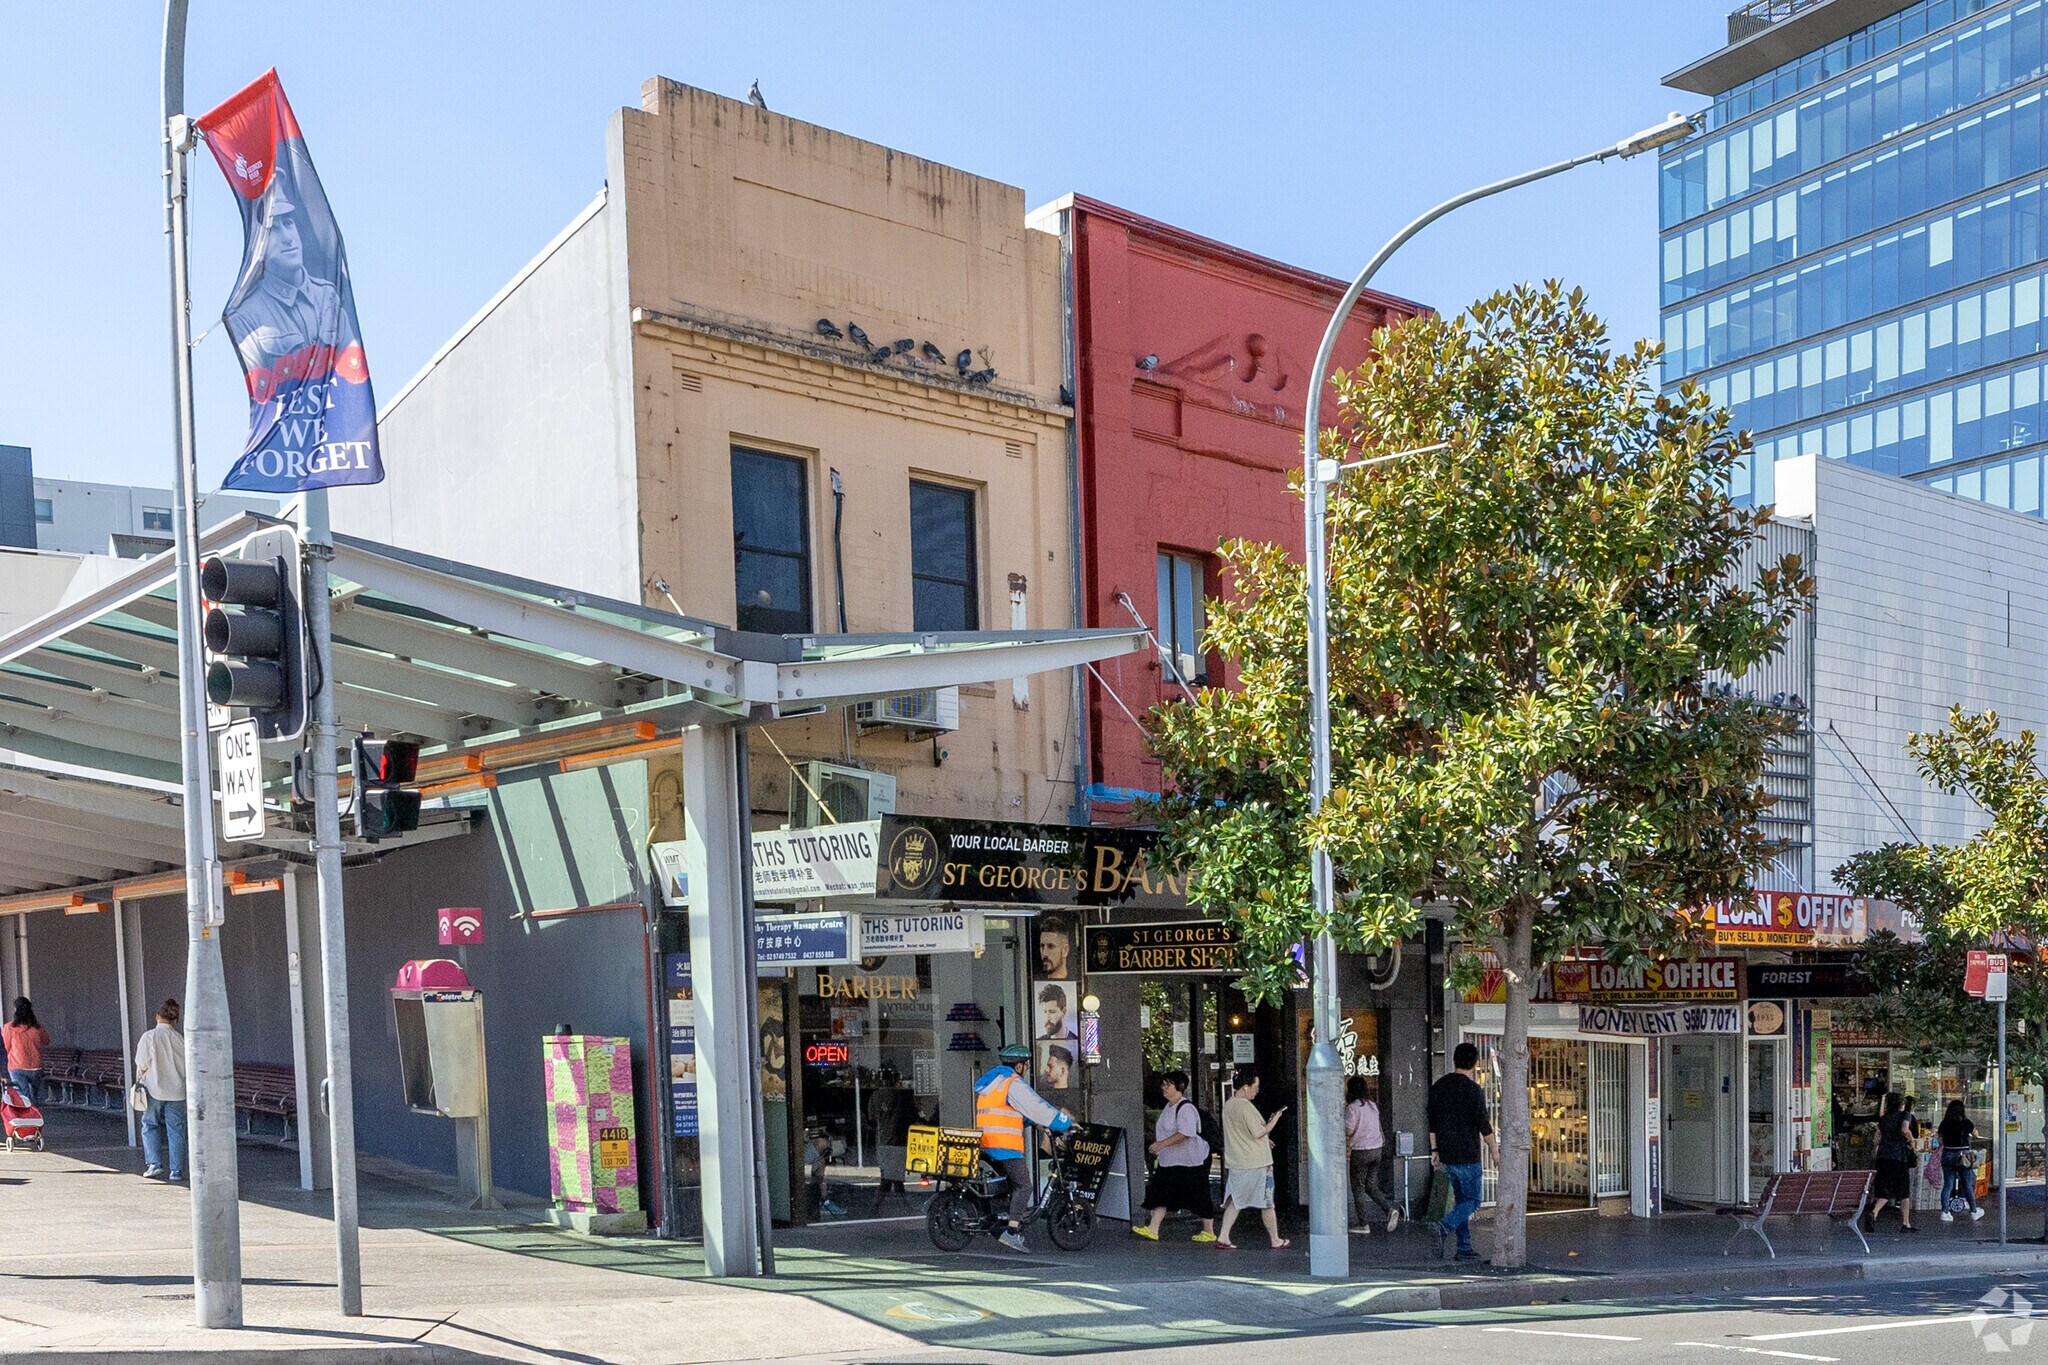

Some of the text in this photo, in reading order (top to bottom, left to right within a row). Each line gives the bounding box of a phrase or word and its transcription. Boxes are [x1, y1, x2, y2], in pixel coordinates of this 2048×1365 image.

[277, 418, 329, 448] WE
[225, 731, 253, 760] ONE
[225, 767, 255, 796] WAY
[788, 832, 873, 864] TUTORING
[949, 834, 1069, 854] YOUR LOCAL BARBER
[663, 854, 680, 864] WMT
[942, 862, 972, 886] ST
[979, 864, 1088, 891] GEORGE'S
[1777, 895, 1793, 929] $
[1796, 895, 1864, 930] OFFICE
[765, 922, 792, 933] Therapy
[793, 920, 819, 931] Massage
[820, 919, 844, 929] Centre
[894, 915, 964, 933] TUTORING
[757, 935, 802, 949] 疗按摩中心
[1133, 927, 1231, 944] ST GEORGE'S
[1718, 931, 1736, 942] BUY,
[1738, 932, 1755, 942] SELL
[1758, 932, 1764, 942] &
[1766, 933, 1793, 943] MONEY
[1794, 934, 1814, 944] LENT
[1118, 948, 1187, 969] BARBER
[1558, 965, 1585, 974] ANNA
[1590, 961, 1736, 992] LOAN $ OFFICE
[1761, 971, 1812, 984] FOREST
[817, 974, 918, 1000] BARBER
[1662, 991, 1680, 999] LENT
[1581, 1007, 1637, 1033] MONEY
[1639, 1011, 1678, 1034] LENT
[1710, 1008, 1737, 1031] 7071
[806, 1045, 849, 1062] OPEN
[601, 1128, 627, 1140] 4418
[1073, 1140, 1111, 1156] BARBER
[1074, 1152, 1102, 1166] SHOP
